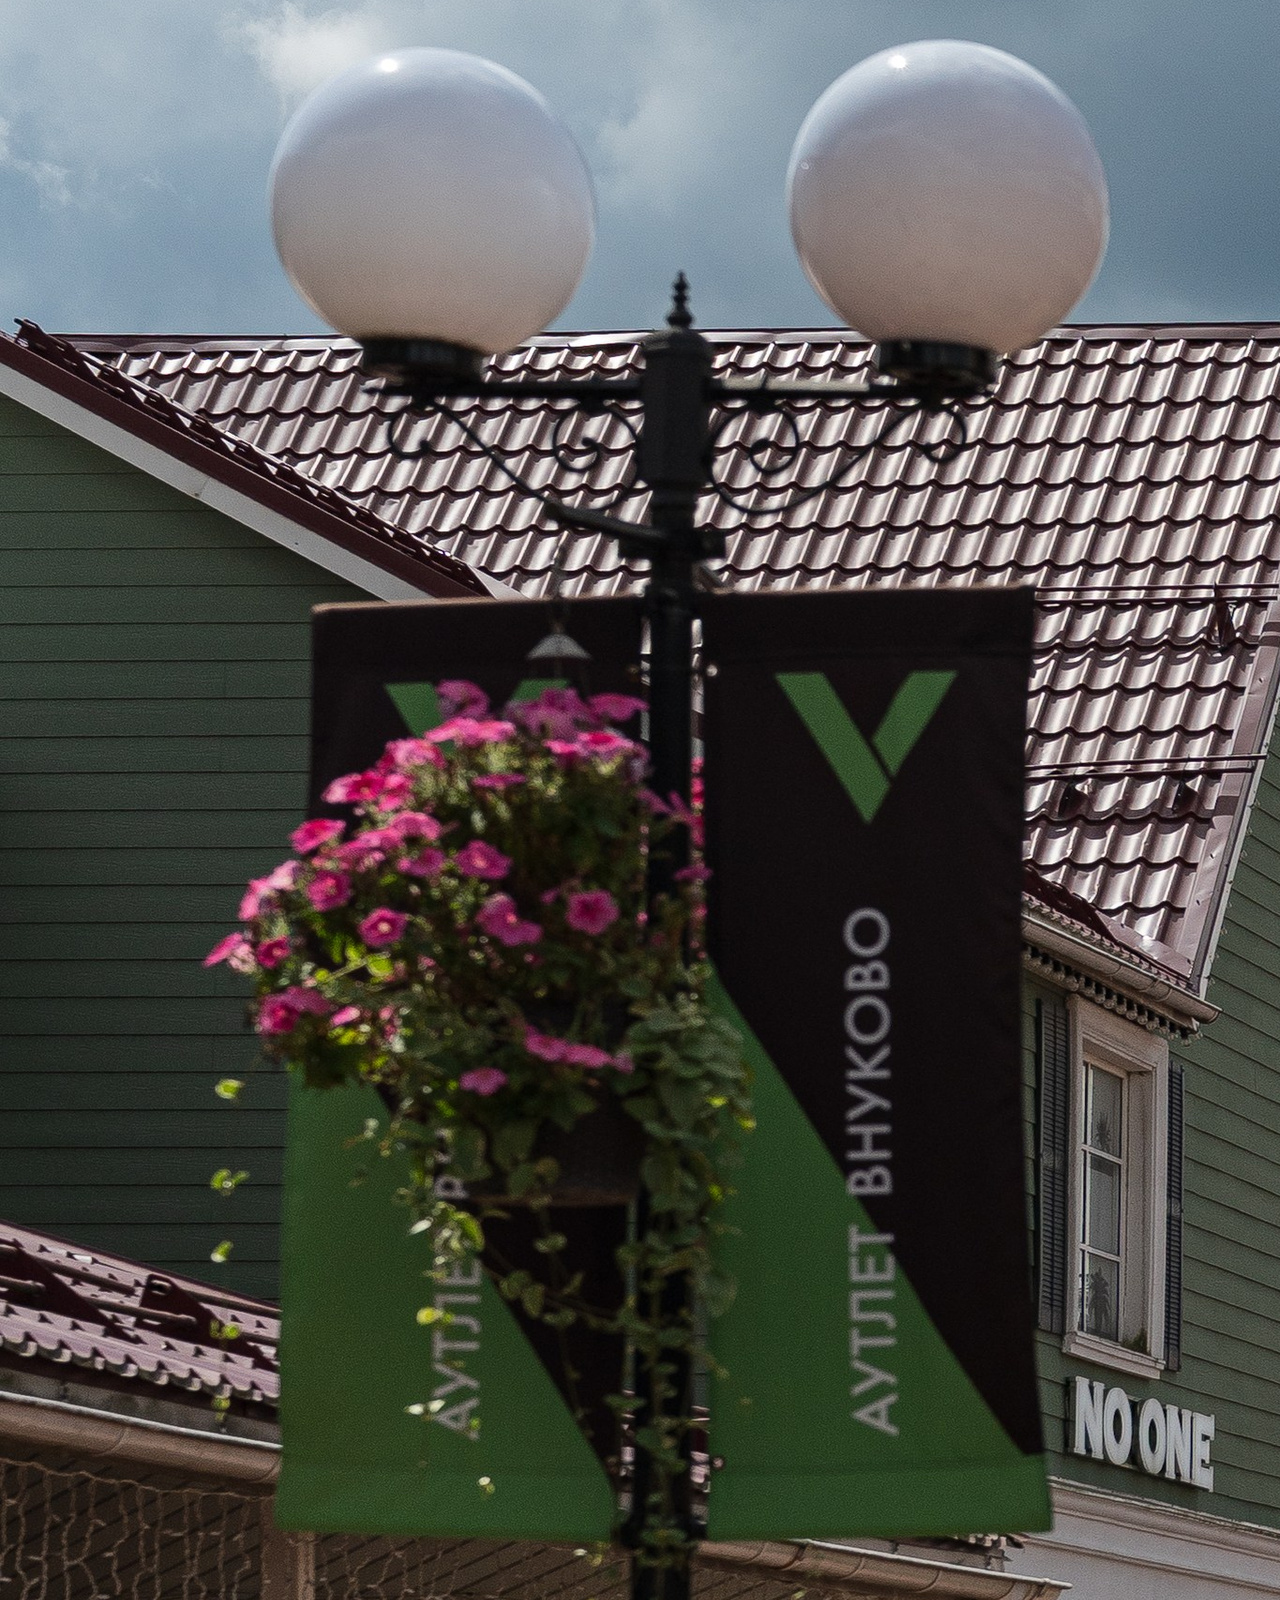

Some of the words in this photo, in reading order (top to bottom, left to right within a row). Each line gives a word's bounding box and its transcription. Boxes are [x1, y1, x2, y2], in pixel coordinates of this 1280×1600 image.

[843, 906, 894, 1197] ВНУКОВО
[432, 1226, 483, 1441] АУТЛЕ
[850, 1224, 900, 1436] АУТЛЕТ
[1069, 1375, 1133, 1466] NO
[1136, 1397, 1215, 1493] ONE
